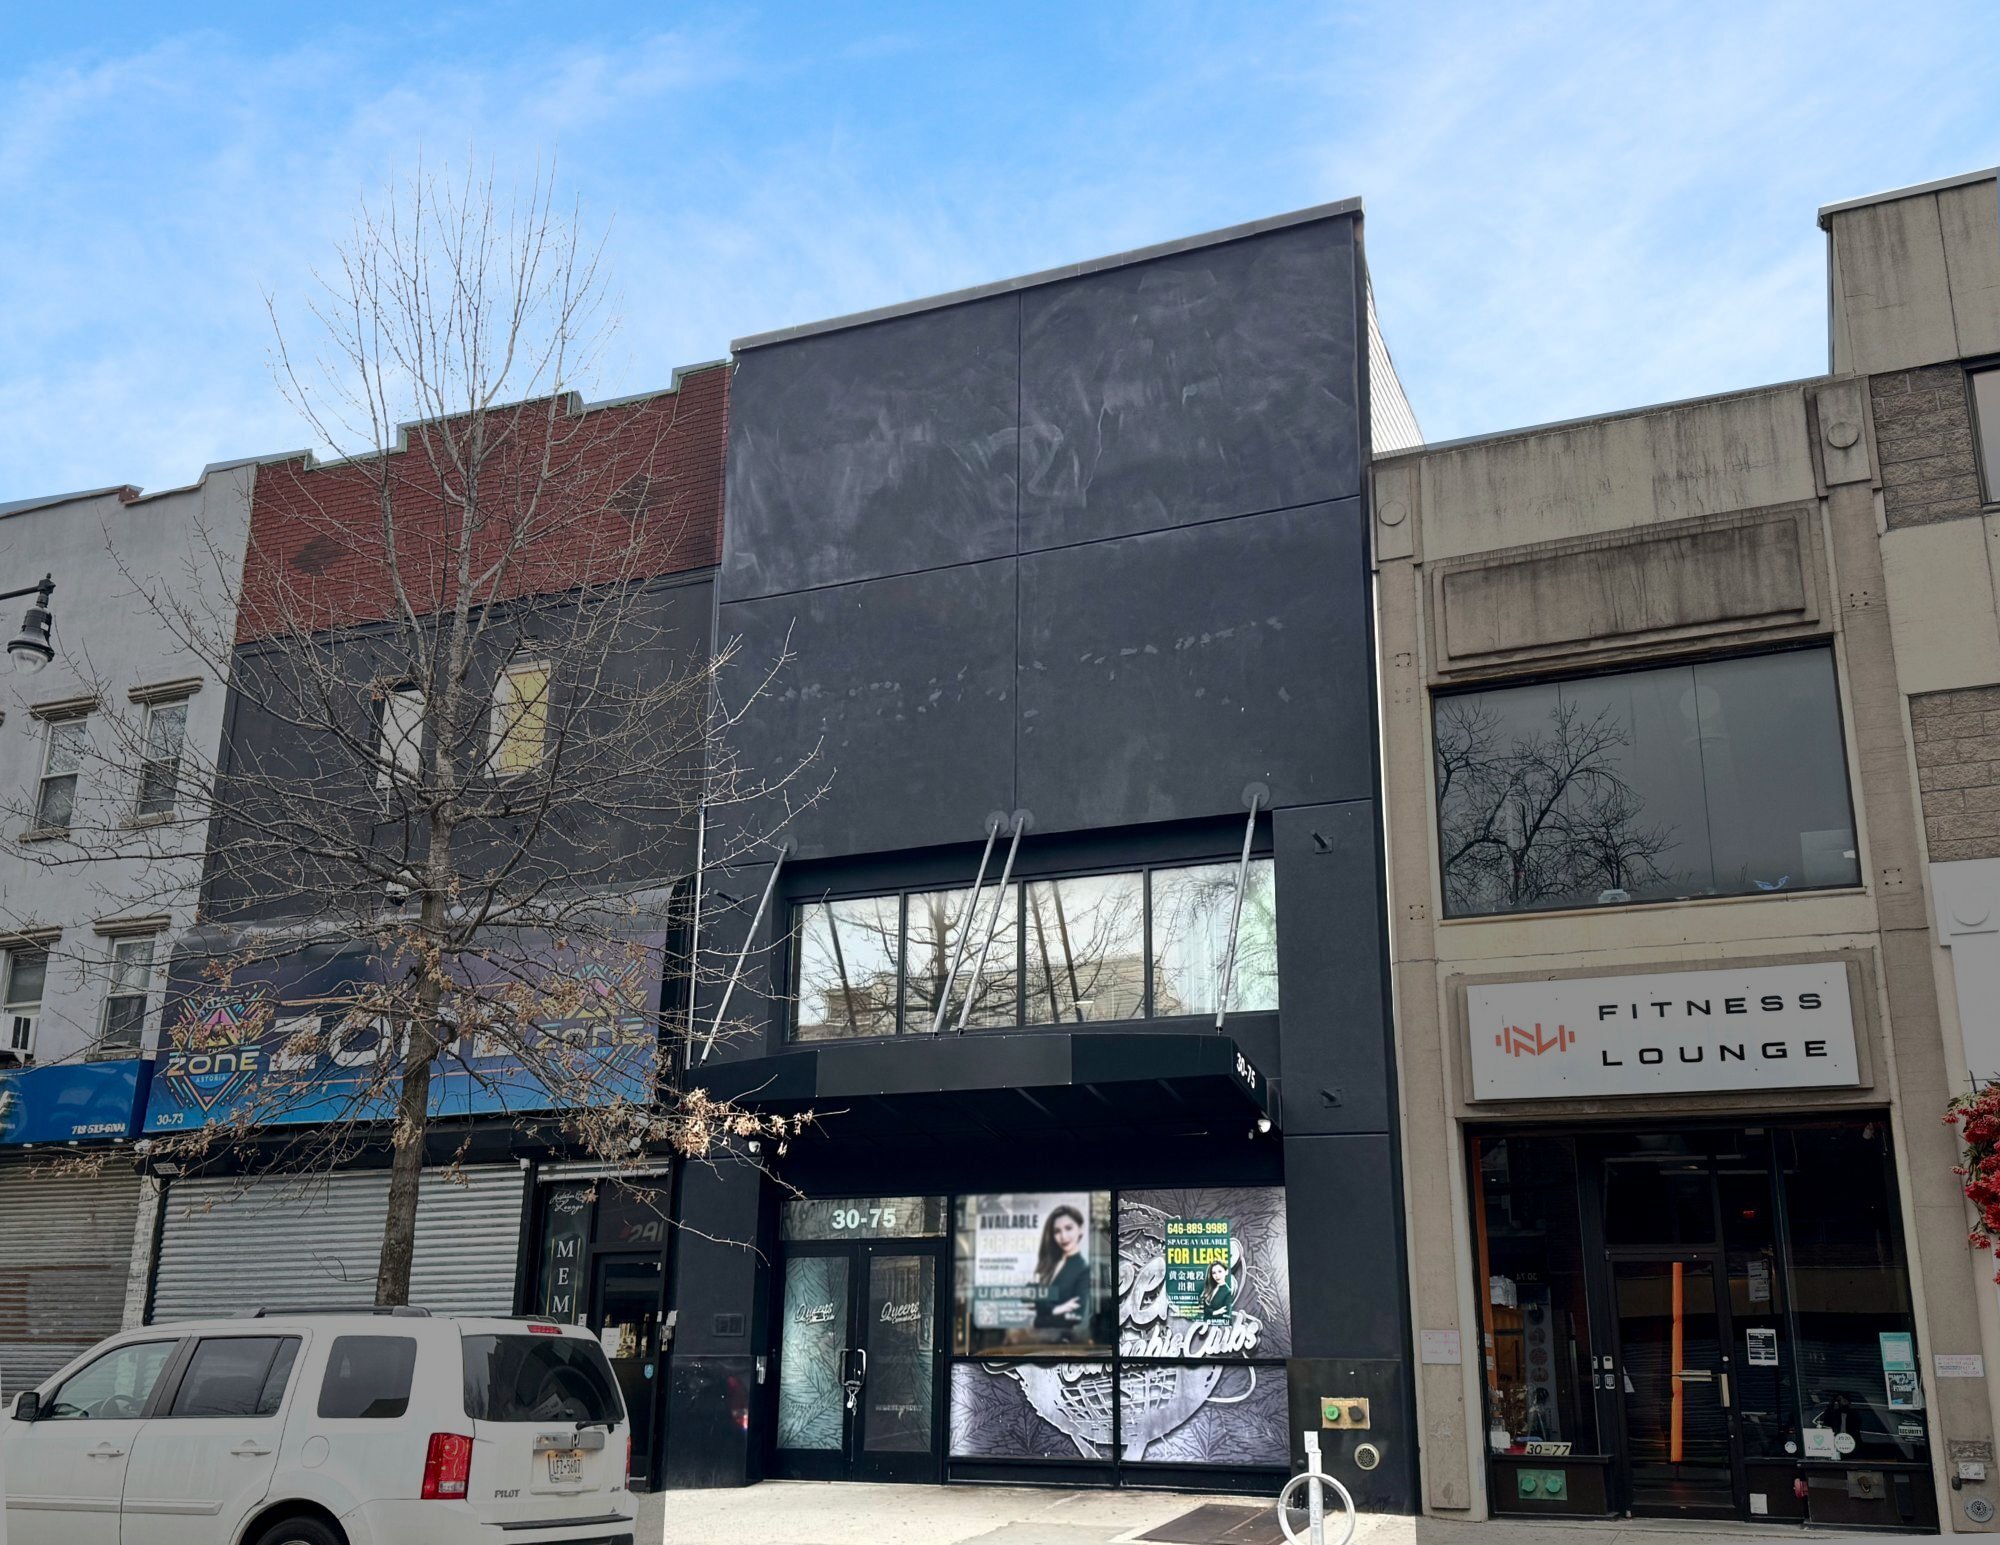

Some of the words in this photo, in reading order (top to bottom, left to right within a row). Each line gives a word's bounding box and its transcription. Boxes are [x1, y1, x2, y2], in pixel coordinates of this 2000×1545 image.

[1598, 992, 1823, 1021] FITNESS
[1602, 1039, 1829, 1067] LOUNGE
[167, 1051, 261, 1077] ZONE
[1235, 1051, 1256, 1089] 30-75
[156, 1112, 184, 1126] 30-73
[831, 1208, 897, 1230] 30-75
[980, 1214, 1039, 1229] AVAILABLE
[1167, 1222, 1228, 1235] 646-889-9988
[1167, 1248, 1190, 1265] FOR
[1193, 1247, 1229, 1265] LEASE
[879, 1301, 920, 1323] Queens
[1526, 1443, 1570, 1456] 30-77
[494, 1489, 520, 1499] PILOT
